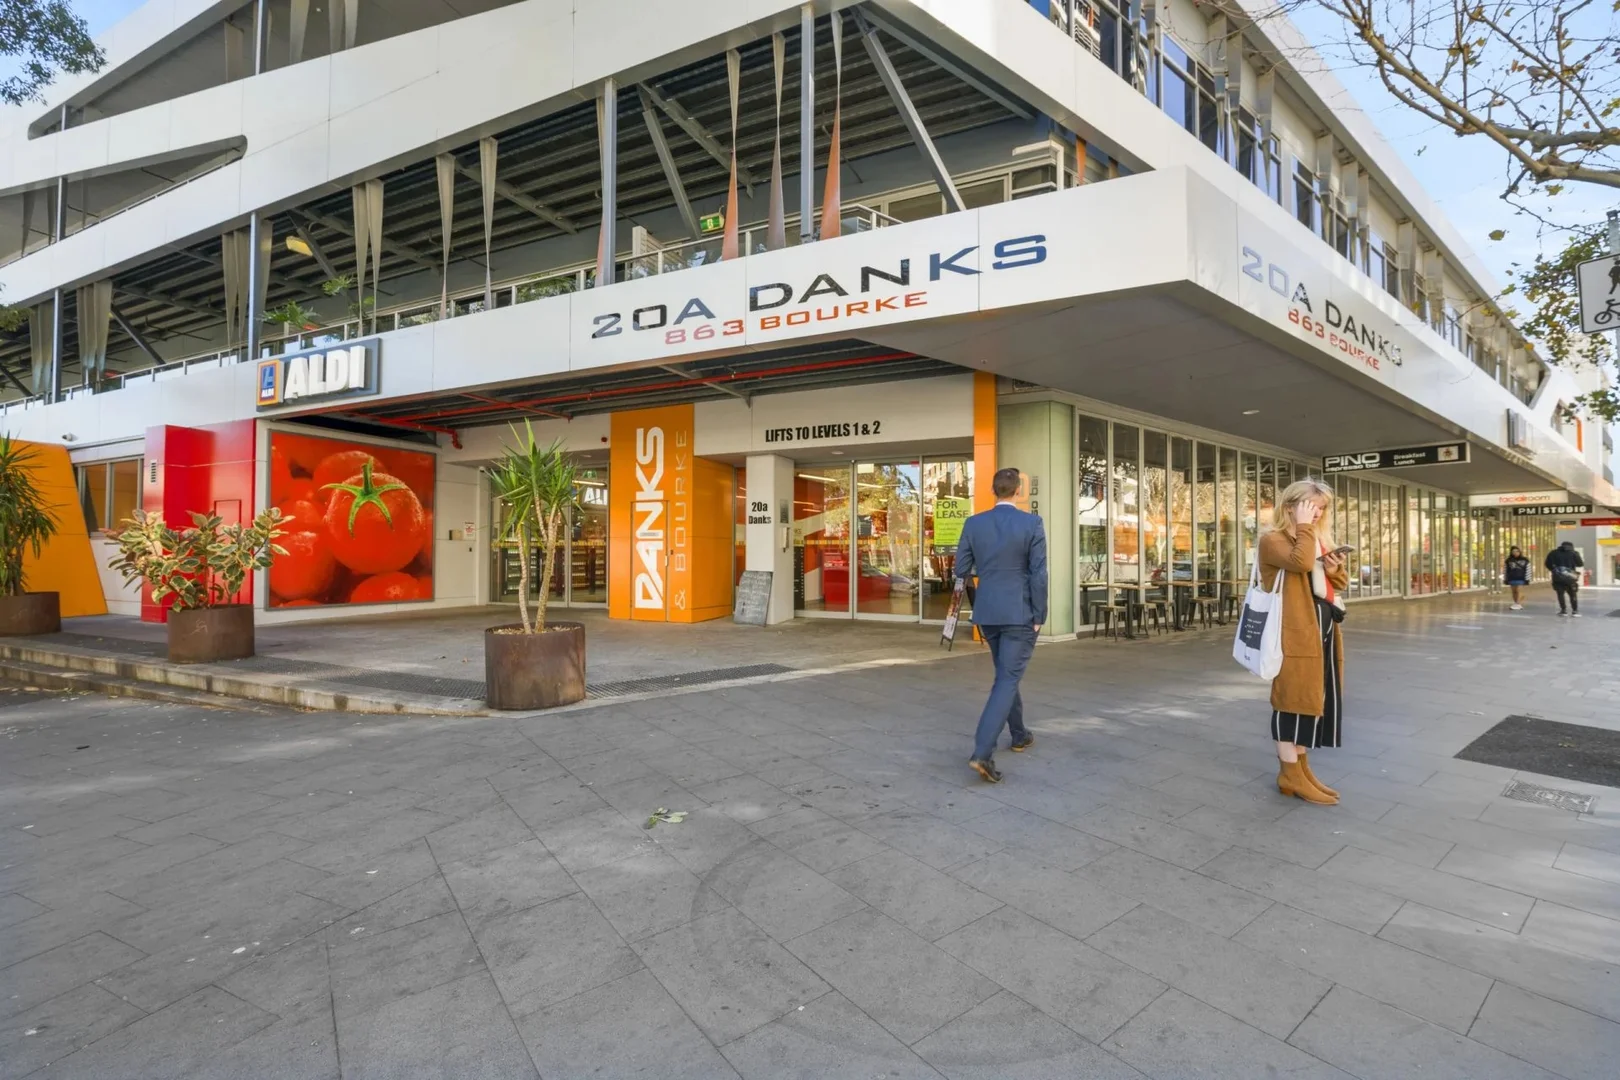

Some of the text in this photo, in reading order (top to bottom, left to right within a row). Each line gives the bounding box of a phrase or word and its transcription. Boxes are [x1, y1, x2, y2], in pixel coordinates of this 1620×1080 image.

[591, 234, 1048, 339] 20A DANKS
[1242, 246, 1403, 367] 20A DANKS
[665, 291, 928, 345] 863 BOURKE
[1288, 307, 1325, 339] 863
[283, 345, 366, 400] ALDI
[261, 388, 275, 398] ALDI
[765, 420, 881, 443] LIFTS TO LEVELS 1 & 2
[1325, 452, 1380, 468] PINO
[1393, 452, 1426, 461] Breakfast
[1325, 464, 1364, 472] espresso
[751, 501, 768, 512] 20a
[936, 500, 958, 510] FOR
[1518, 505, 1588, 516] PM STUDIO
[634, 426, 665, 610] DANKS
[675, 430, 687, 610] & BOURKE
[748, 515, 772, 525] Danks
[936, 510, 969, 519] LEASE
